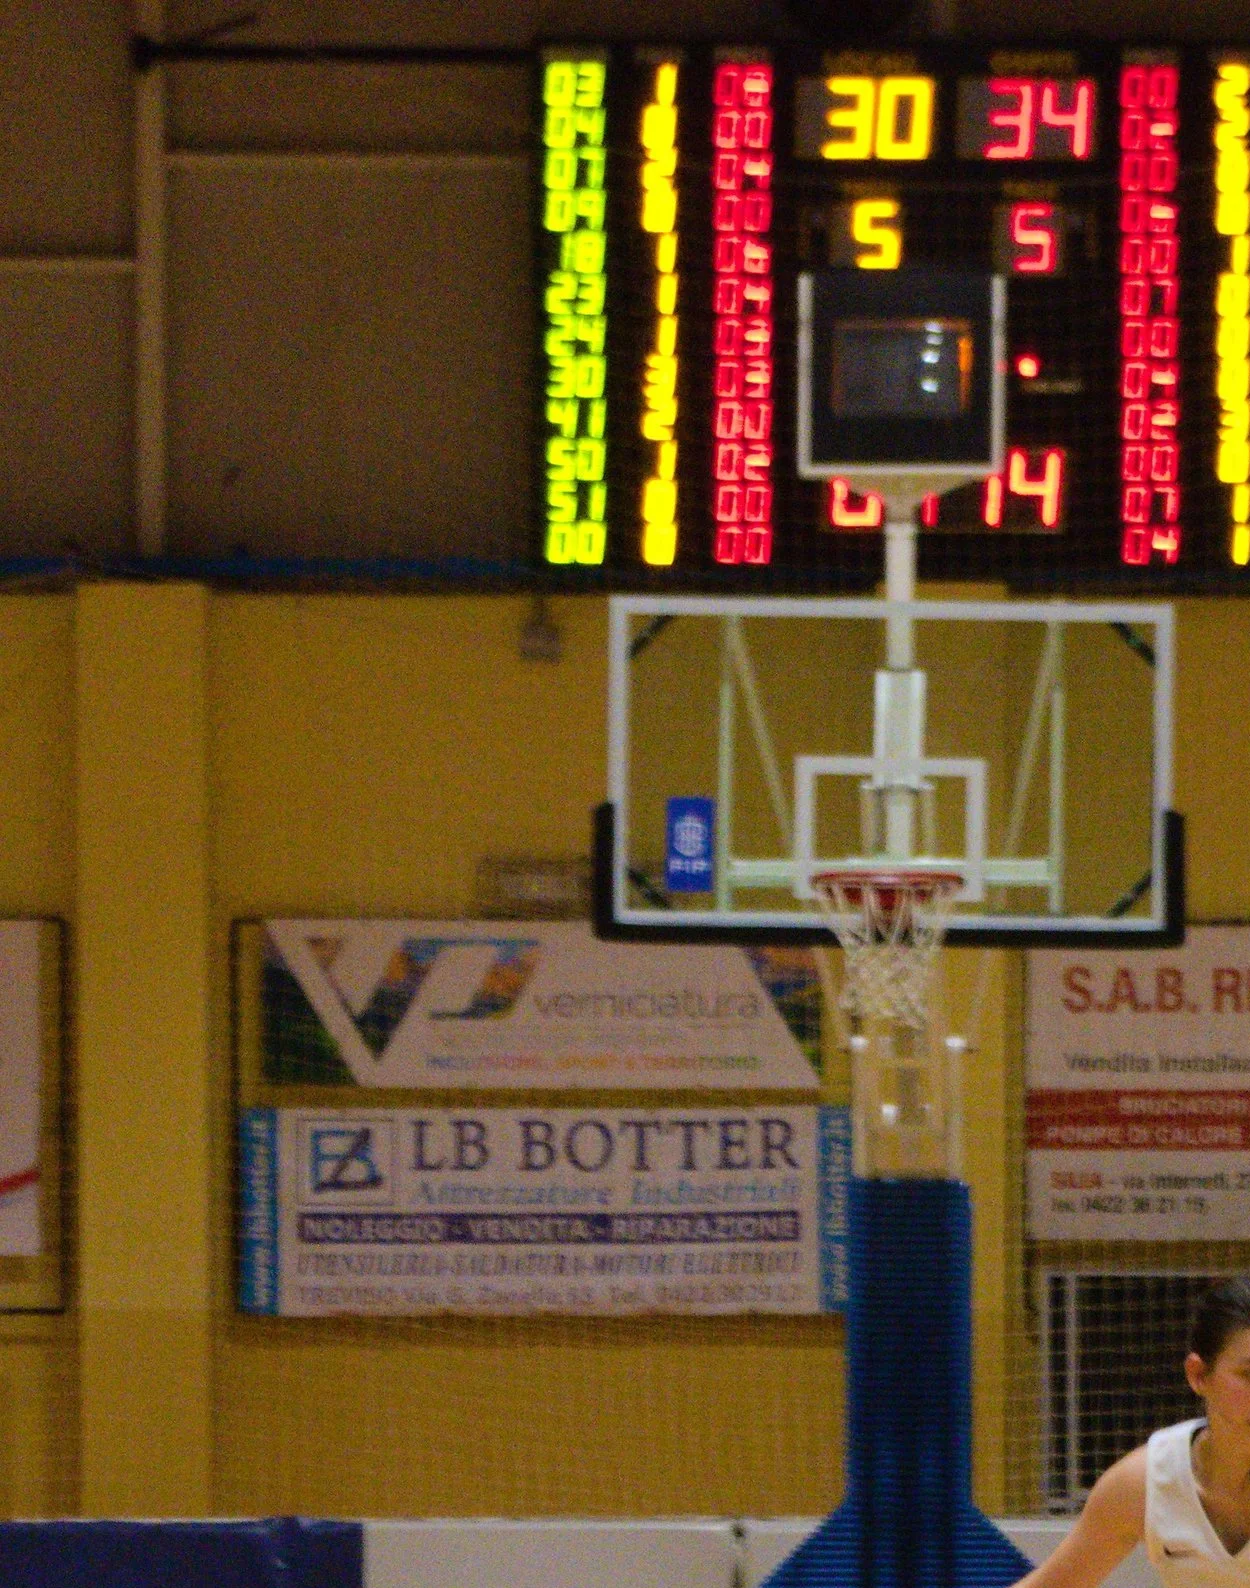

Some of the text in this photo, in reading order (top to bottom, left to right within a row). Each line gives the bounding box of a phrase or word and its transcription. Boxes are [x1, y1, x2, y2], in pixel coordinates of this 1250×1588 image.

[821, 74, 934, 160] 30
[984, 76, 1098, 159] 34
[850, 199, 902, 270] 5
[1010, 203, 1057, 272] 5
[983, 446, 1064, 528] 14
[1061, 965, 1197, 1014] S.A.B.
[1064, 1053, 1150, 1074] Vendita
[410, 1118, 800, 1172] LB BOTTER
[304, 1217, 443, 1241] NOLEGGIO
[469, 1216, 589, 1240] VENDITA
[612, 1215, 798, 1239] RIPARAZIONE
